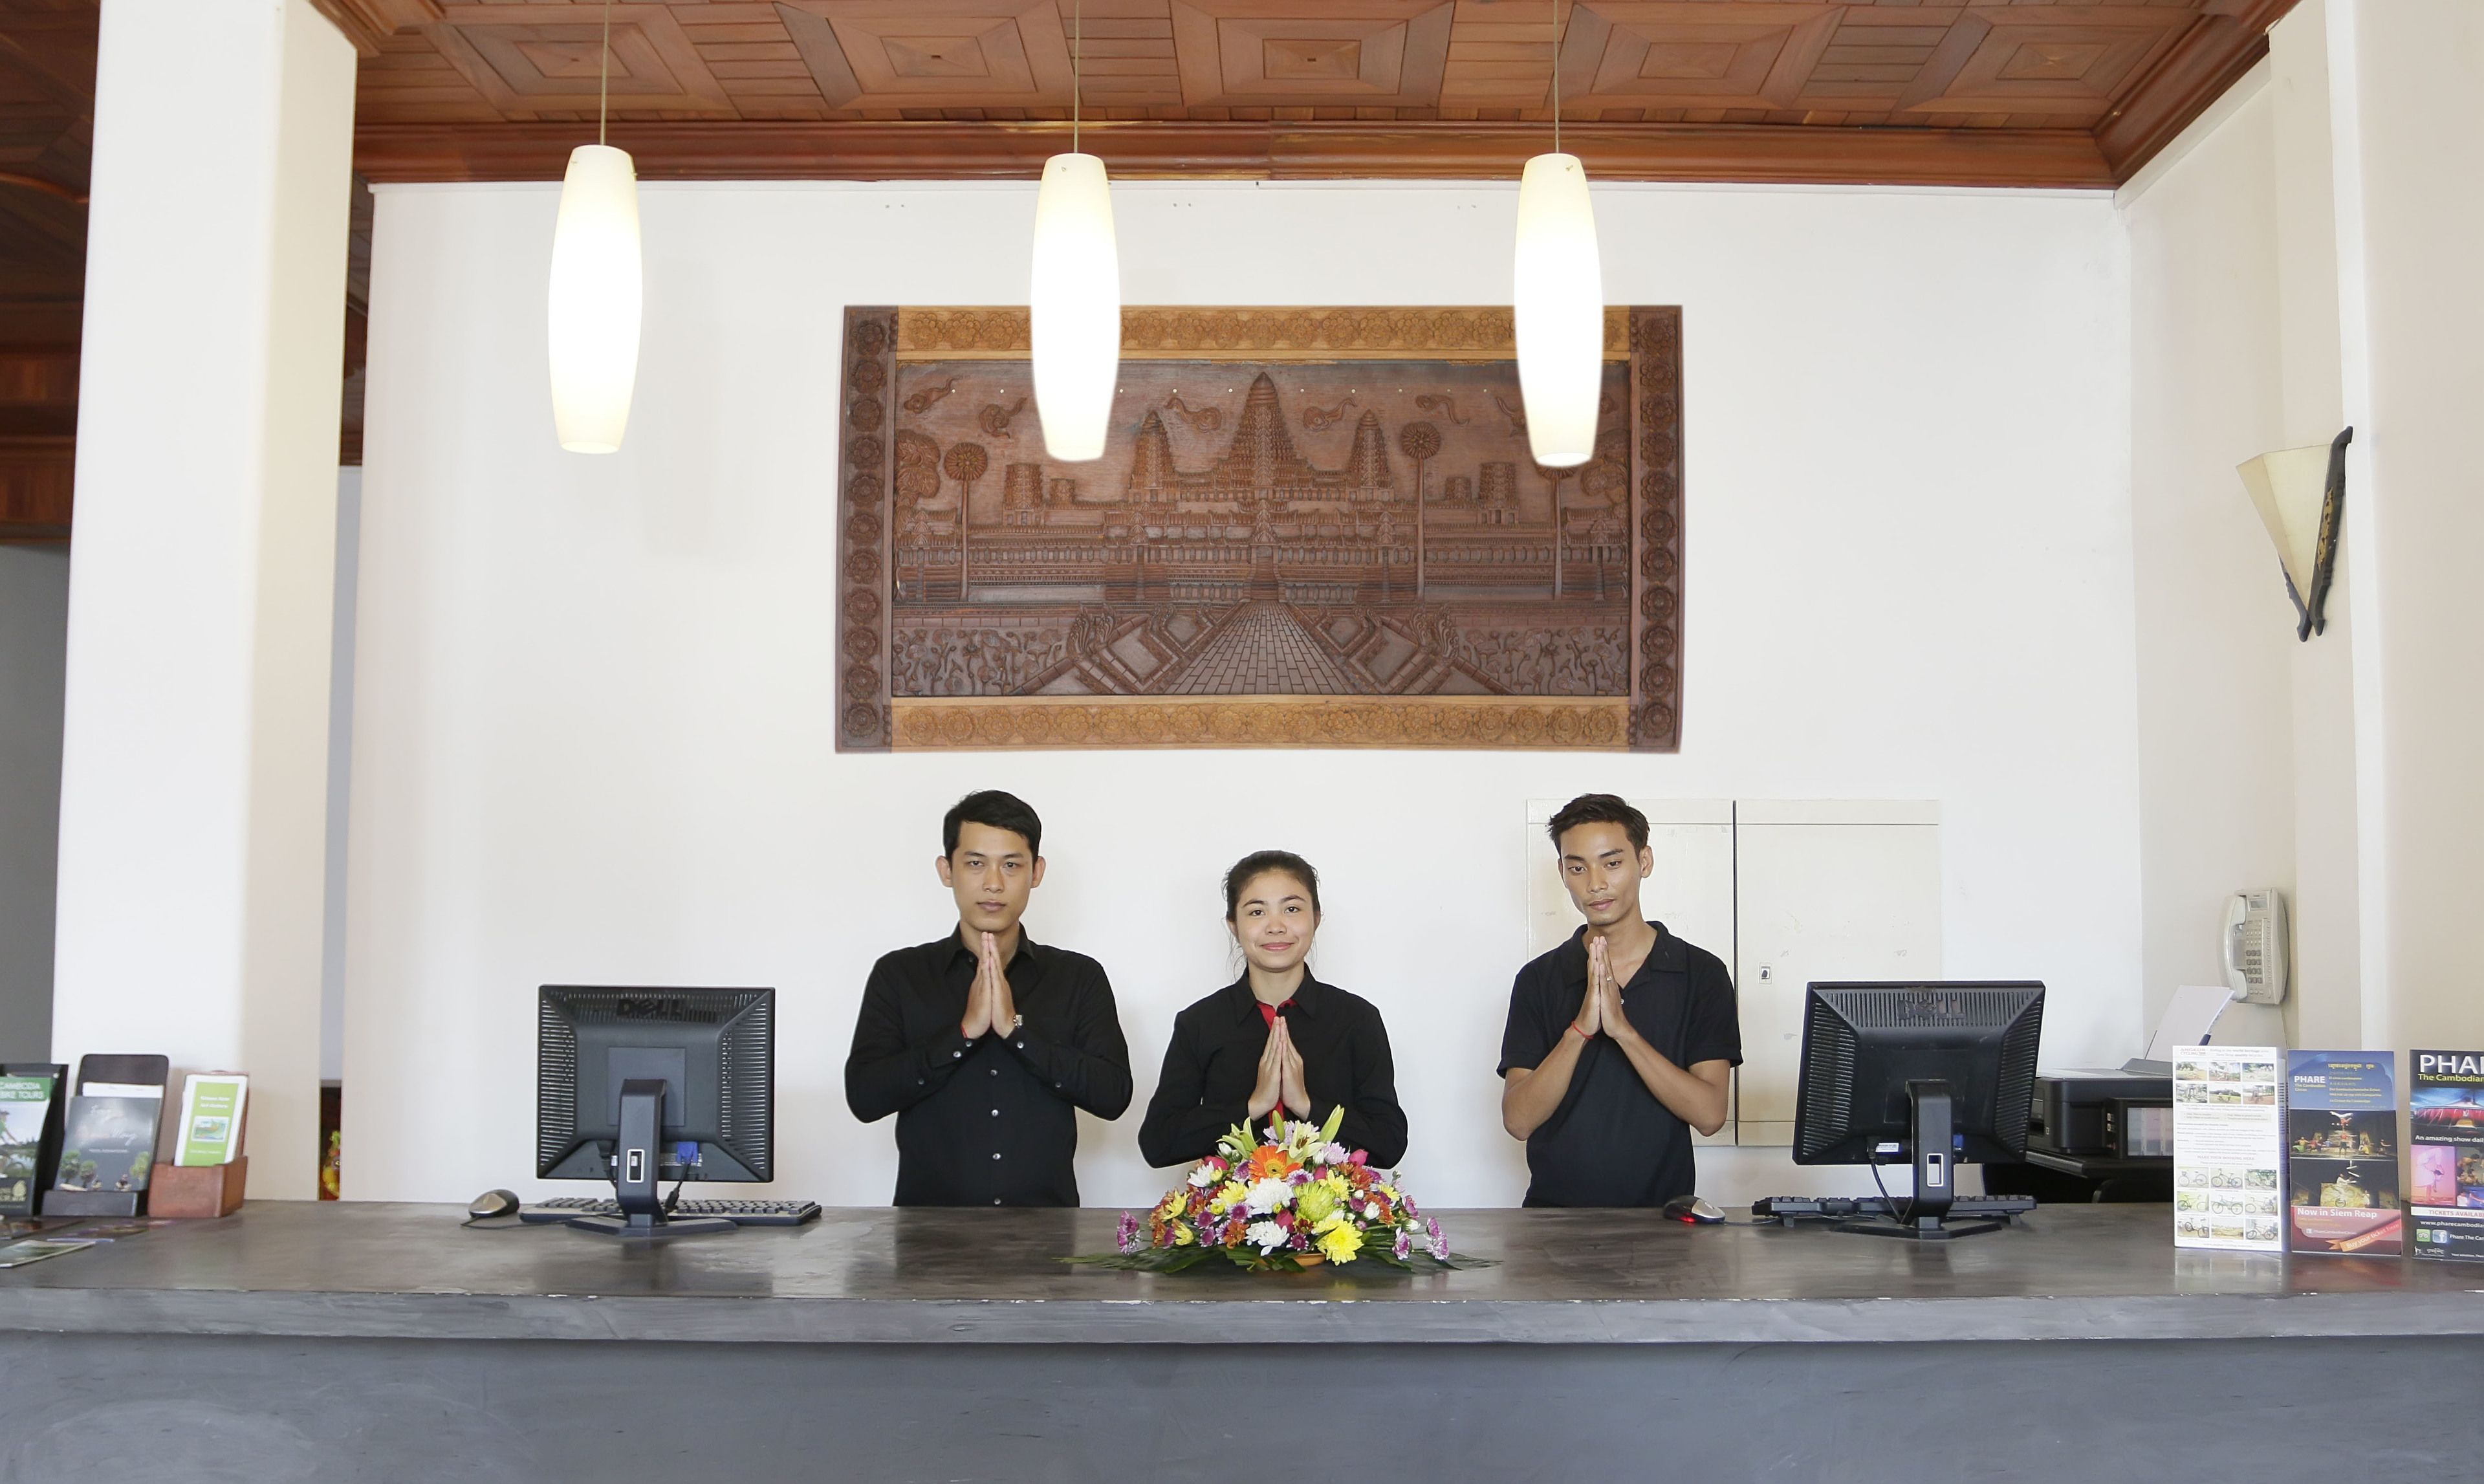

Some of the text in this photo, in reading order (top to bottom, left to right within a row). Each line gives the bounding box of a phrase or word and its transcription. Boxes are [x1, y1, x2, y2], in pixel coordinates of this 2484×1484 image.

[1897, 999, 1965, 1020] DELL
[2355, 1210, 2377, 1219] Reap
[2346, 1240, 2358, 1249] Buy
[2358, 1235, 2371, 1245] your
[2370, 1228, 2386, 1238] ticket
